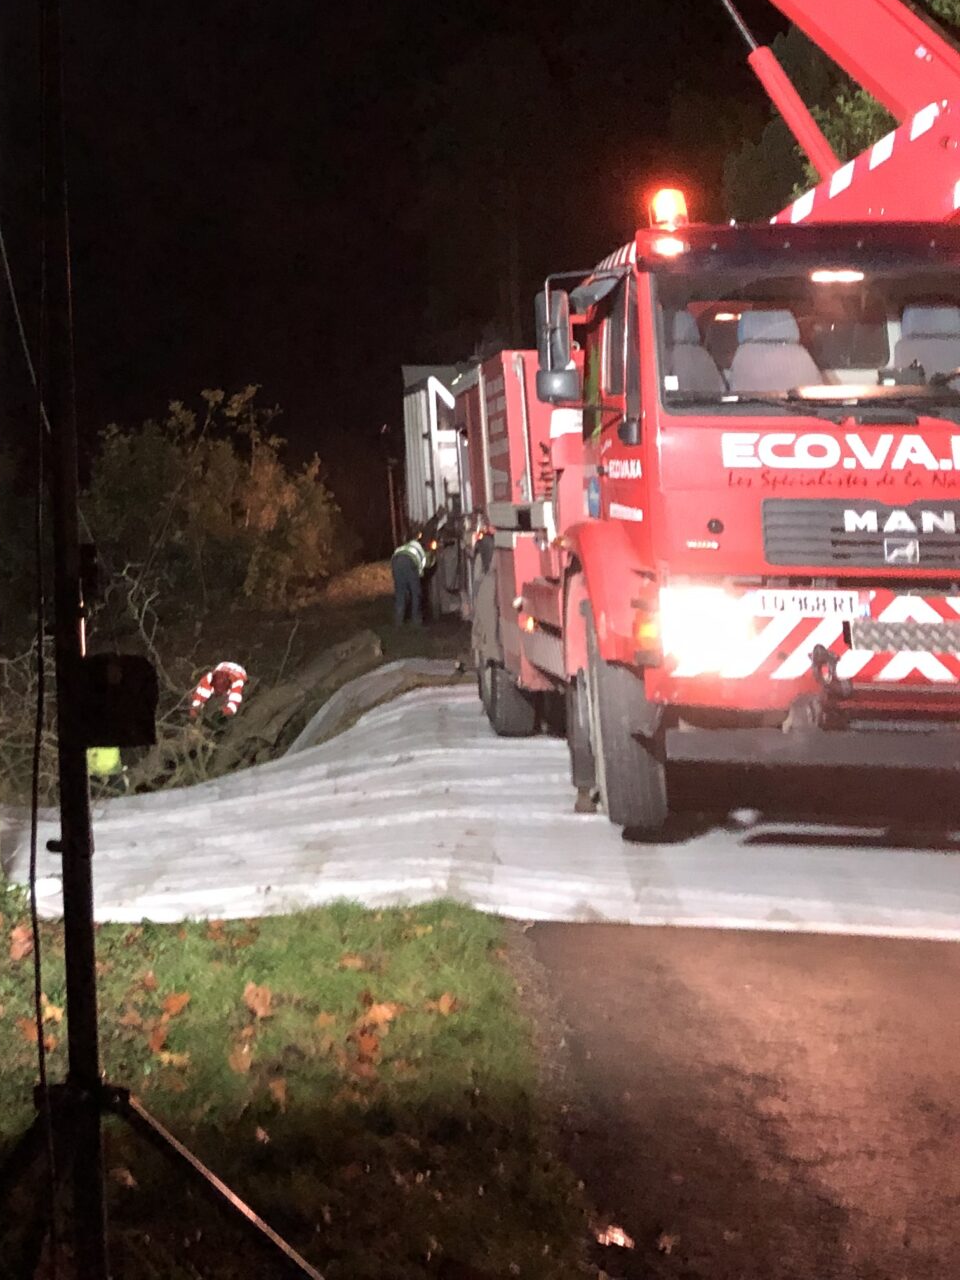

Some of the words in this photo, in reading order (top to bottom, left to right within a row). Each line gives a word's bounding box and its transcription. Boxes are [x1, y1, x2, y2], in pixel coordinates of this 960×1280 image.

[721, 432, 960, 470] ECO.VA.
[728, 471, 752, 488] Les
[876, 472, 896, 487] de
[903, 471, 924, 487] la
[843, 509, 956, 534] MAN
